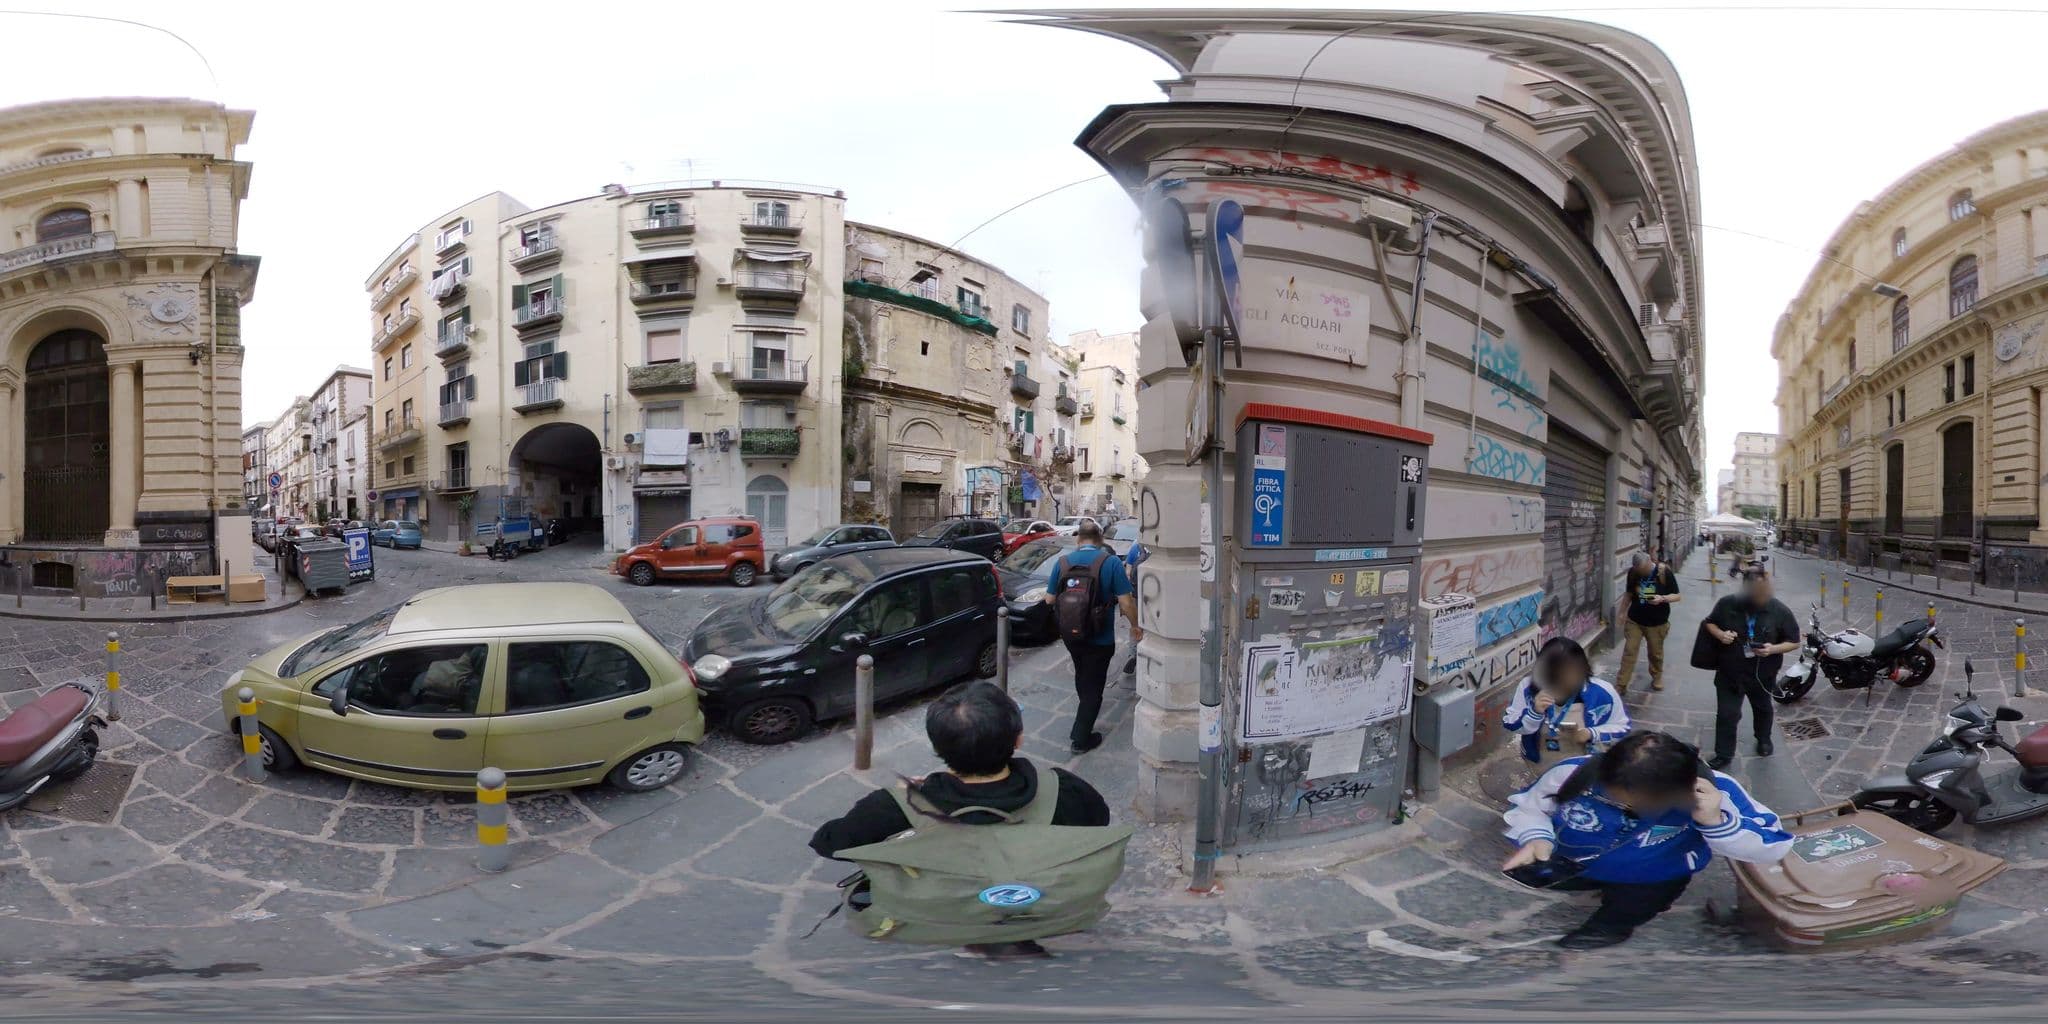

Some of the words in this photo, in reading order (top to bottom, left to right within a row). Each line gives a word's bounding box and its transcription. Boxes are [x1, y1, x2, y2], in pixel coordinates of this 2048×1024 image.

[1276, 288, 1300, 301] VIA
[1246, 308, 1268, 320] GLI
[1281, 313, 1341, 333] ACQUARI
[1255, 485, 1281, 493] OTTICA
[1263, 534, 1280, 542] TIM
[349, 537, 366, 561] P
